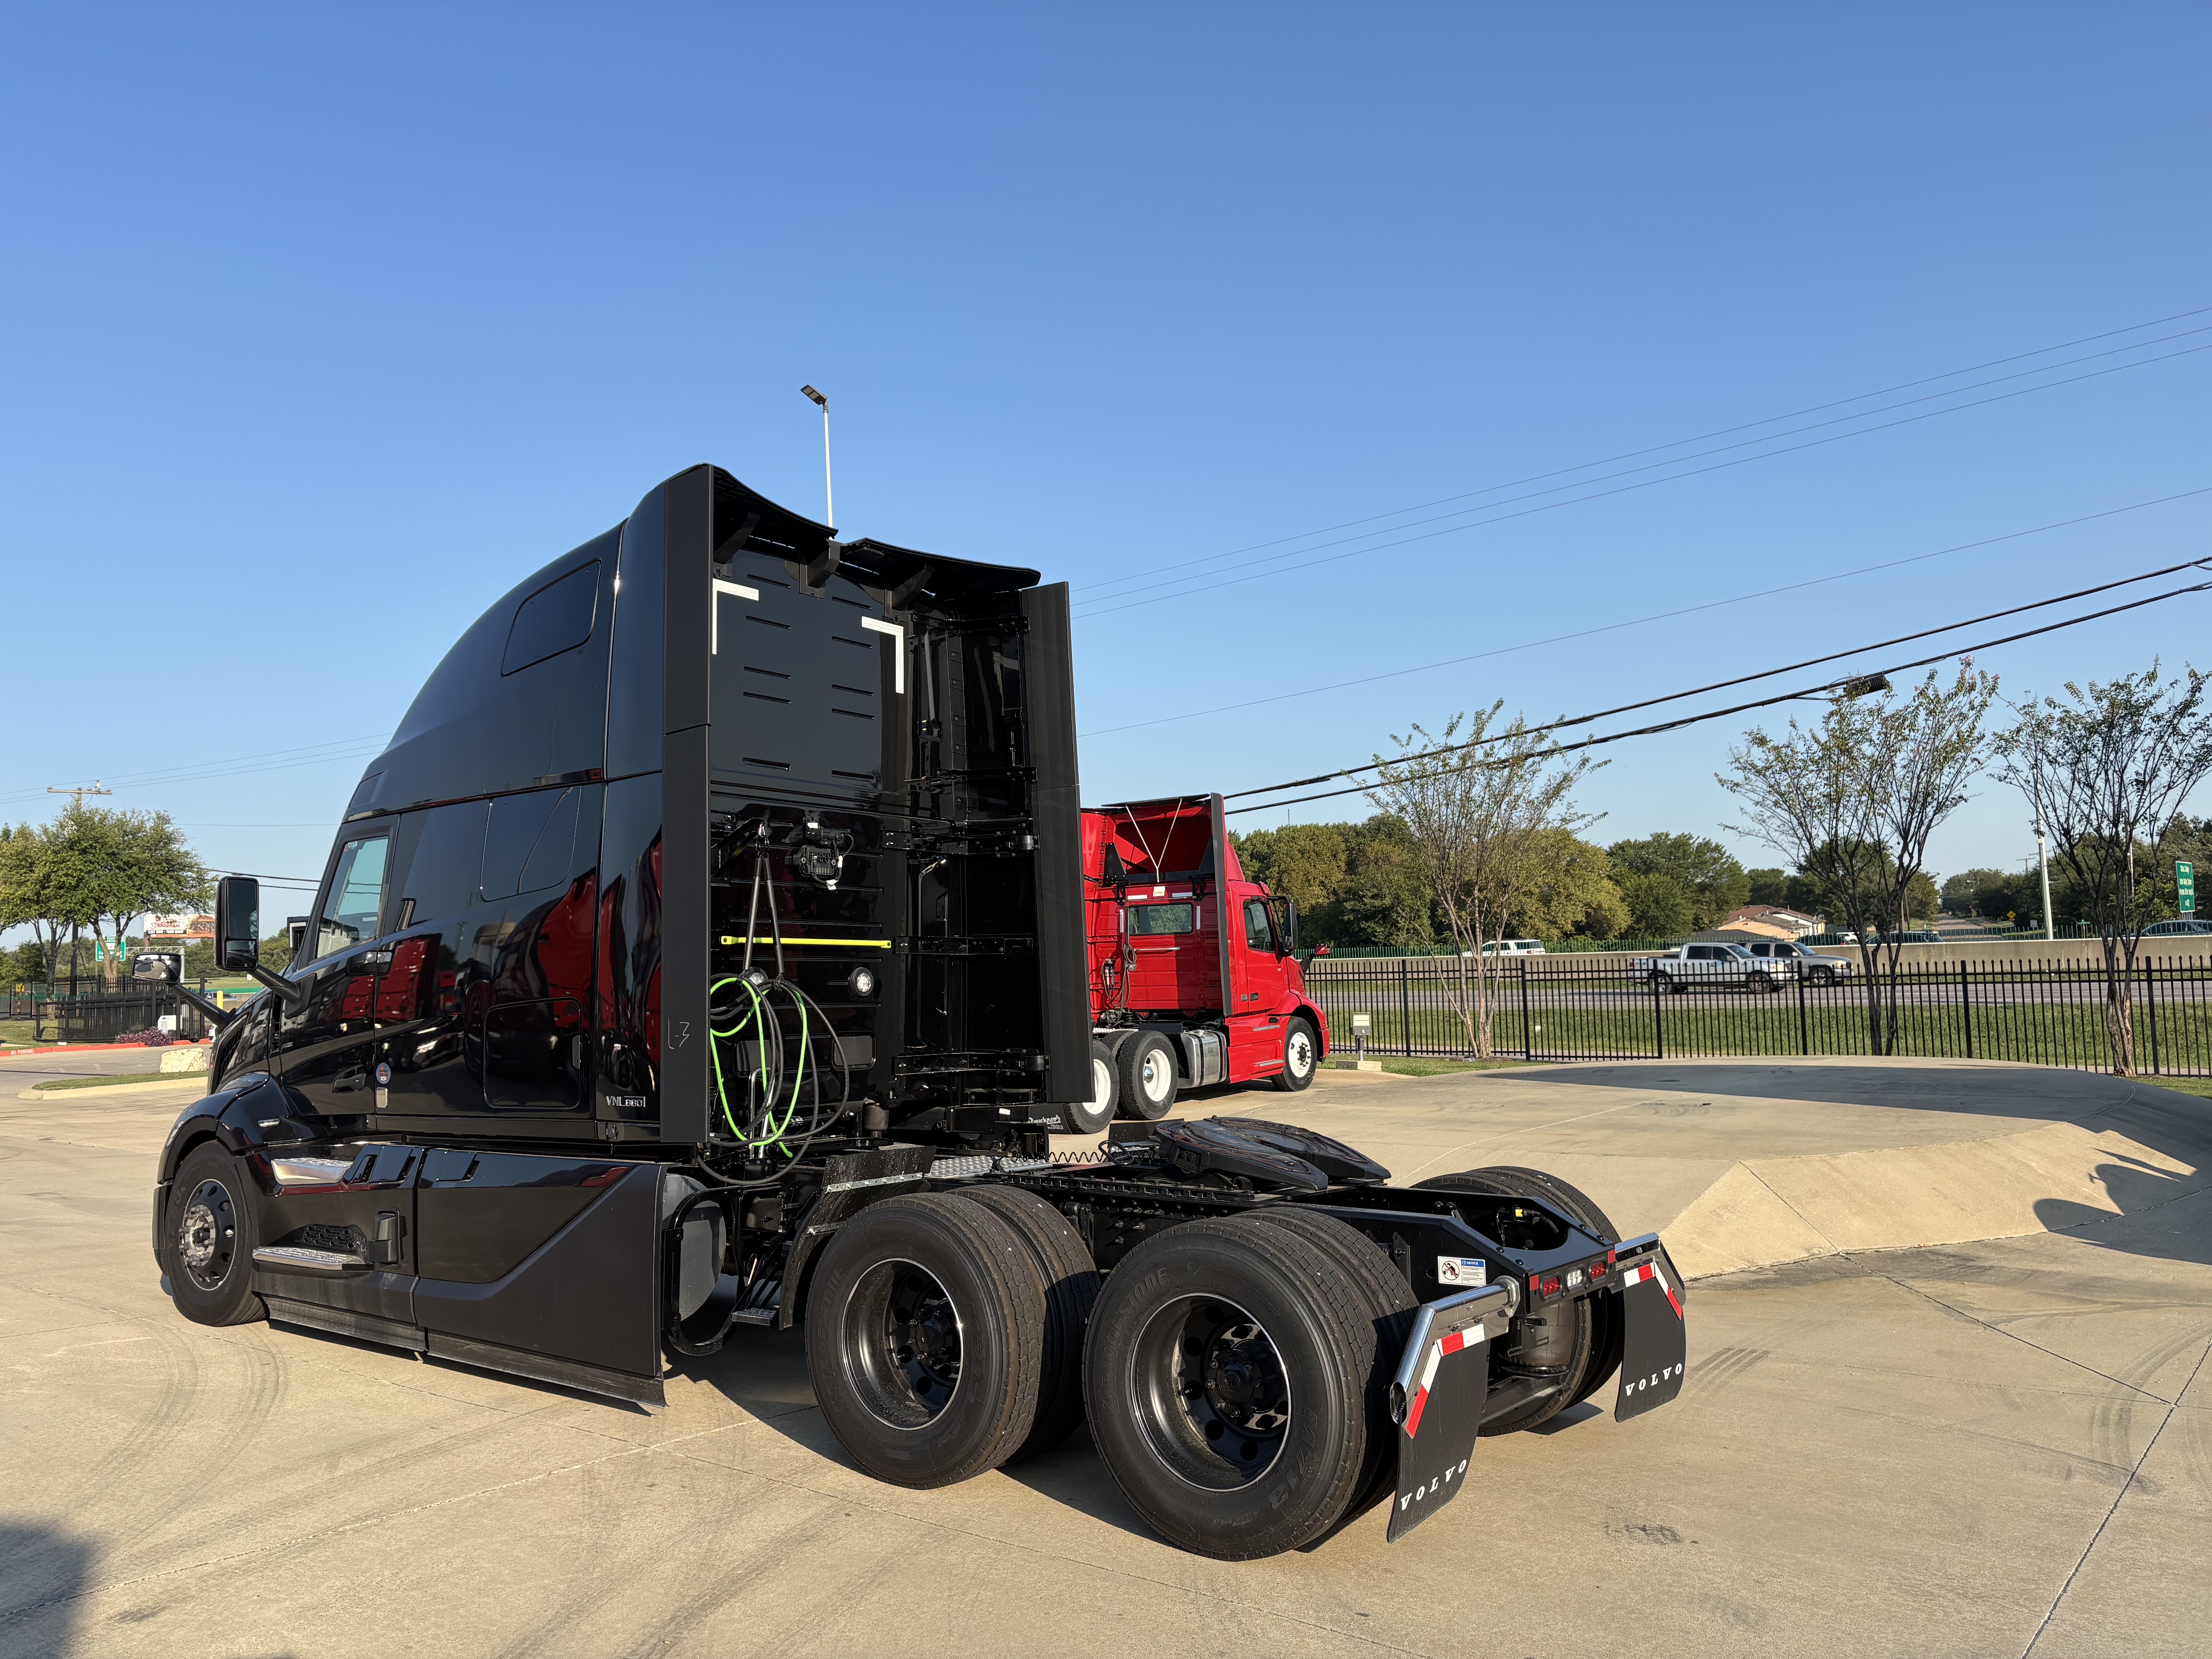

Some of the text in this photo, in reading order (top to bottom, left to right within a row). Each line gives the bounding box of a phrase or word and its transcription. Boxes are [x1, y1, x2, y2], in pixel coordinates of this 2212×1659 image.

[1101, 1266, 1169, 1413] BRIDGESTONE
[1625, 1363, 1682, 1396] VOLVO
[1268, 1406, 1317, 1510] M713
[1401, 1459, 1467, 1511] VOLVO
